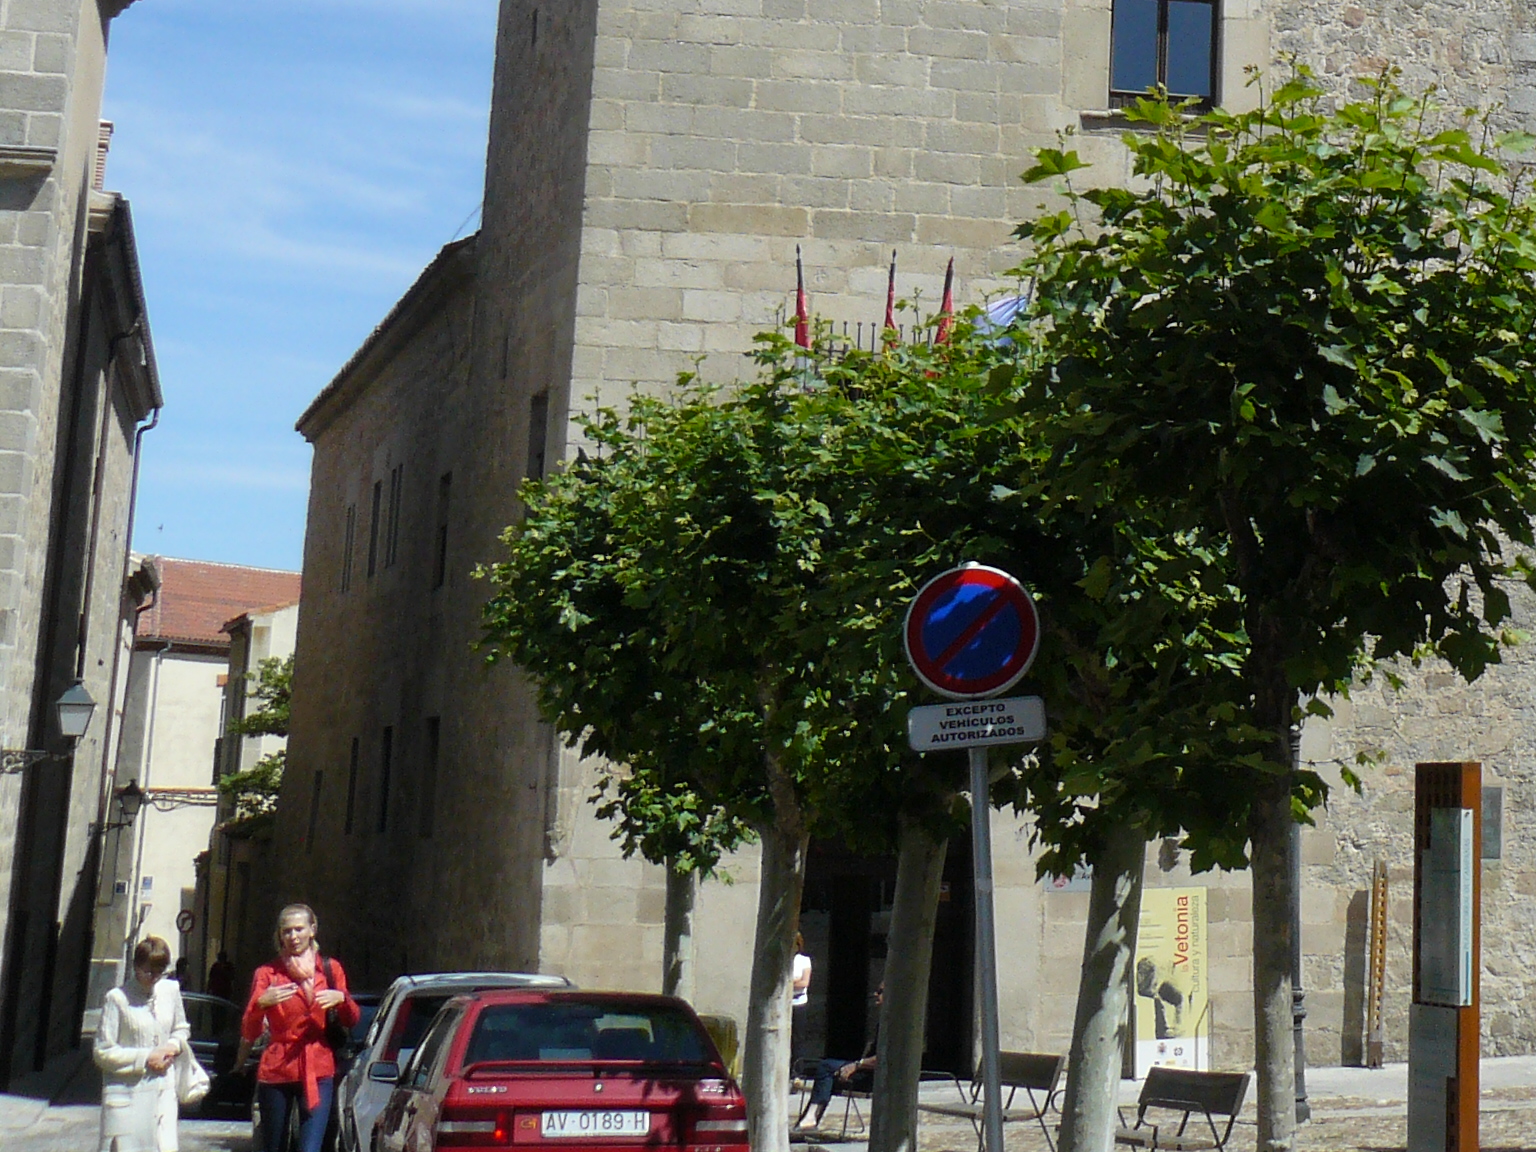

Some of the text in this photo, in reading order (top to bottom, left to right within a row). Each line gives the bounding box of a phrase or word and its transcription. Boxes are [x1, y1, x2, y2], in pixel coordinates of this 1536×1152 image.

[939, 715, 1015, 730] VEHÍCULOS
[946, 703, 1005, 717] EXCEPTO
[931, 726, 1025, 743] AUTORIZADOS
[1173, 895, 1189, 966] Vetonia
[1191, 895, 1200, 947] naturaleza
[1191, 958, 1200, 993] cultura
